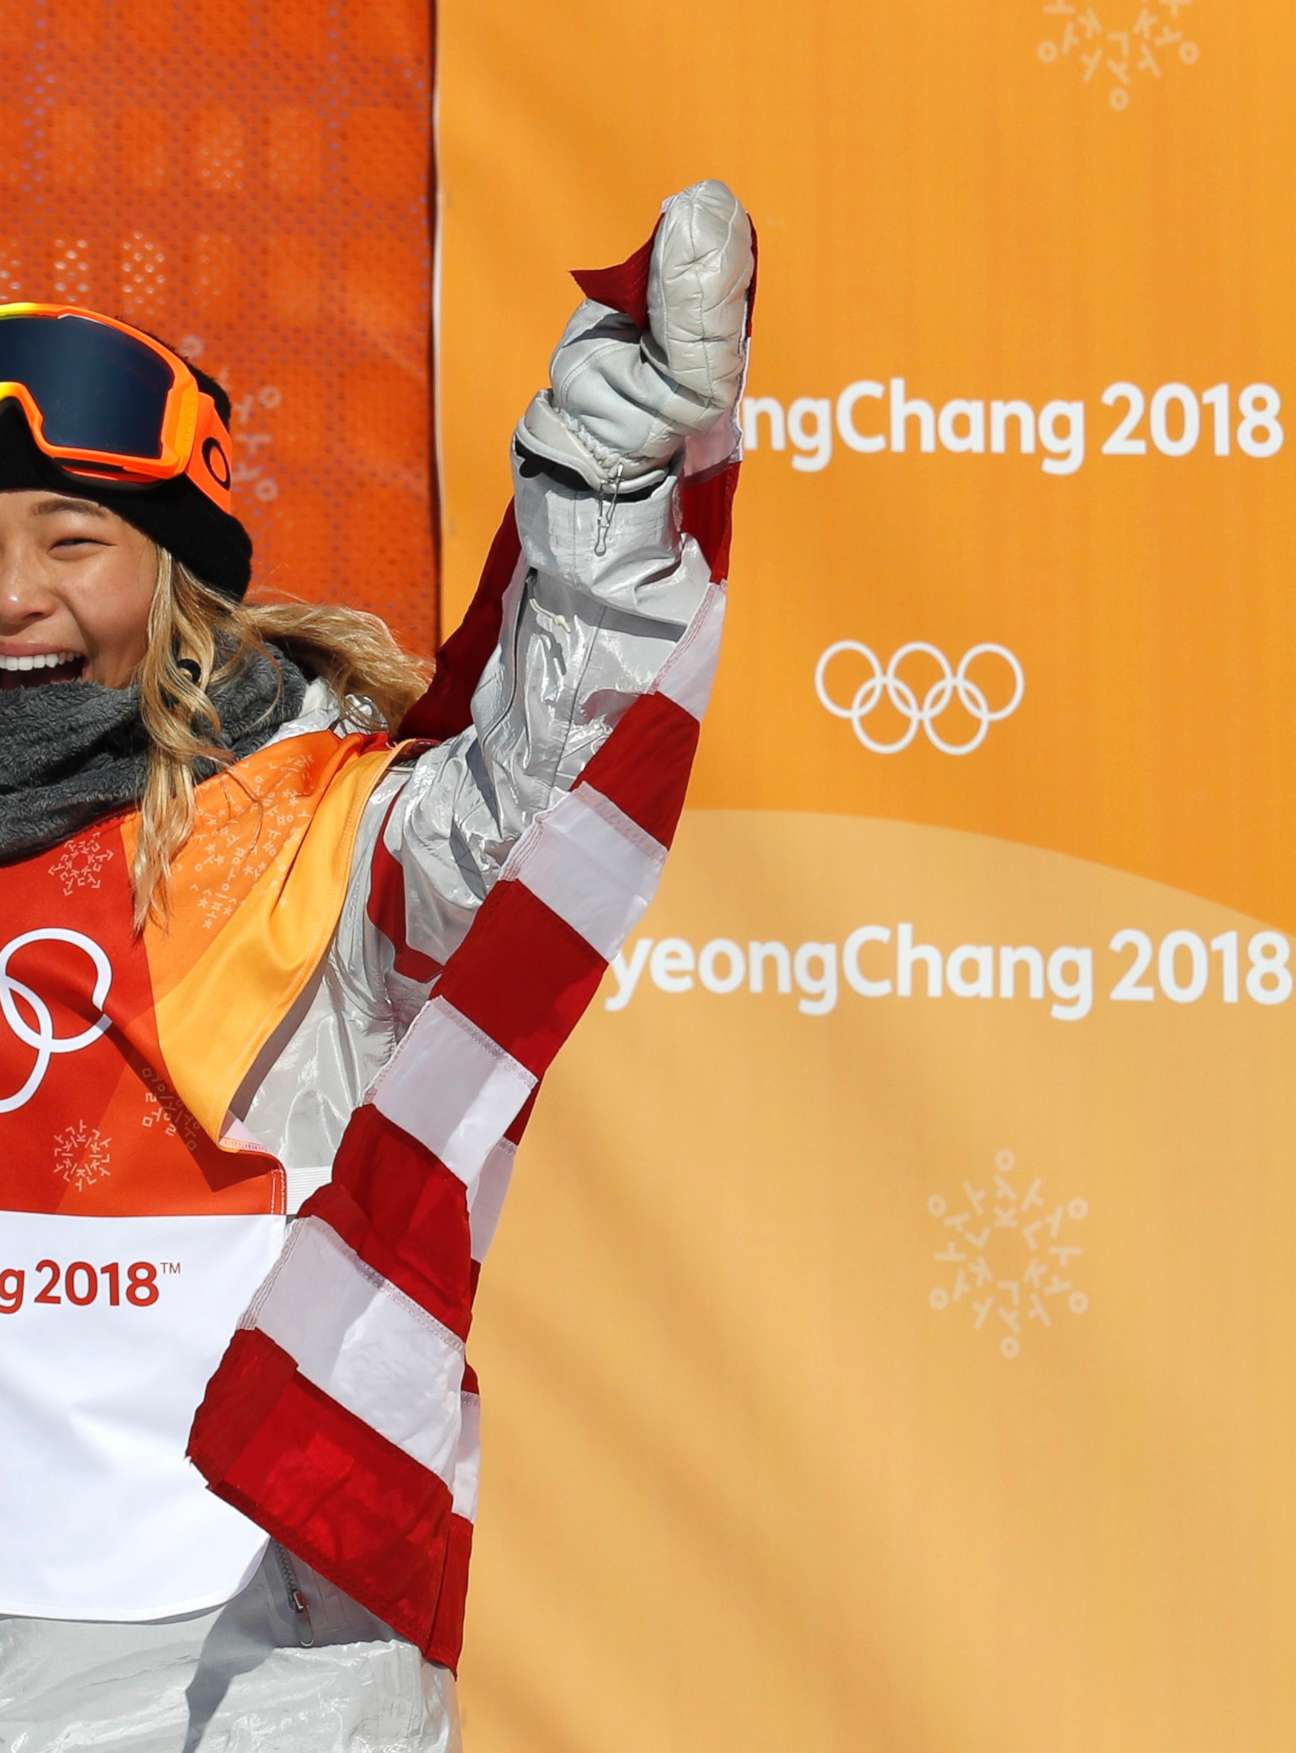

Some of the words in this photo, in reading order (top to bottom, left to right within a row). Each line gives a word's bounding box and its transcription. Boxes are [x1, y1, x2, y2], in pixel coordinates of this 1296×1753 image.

[1100, 382, 1283, 458] 2018
[1108, 928, 1293, 1005] 2018
[33, 1259, 160, 1307] 2018
